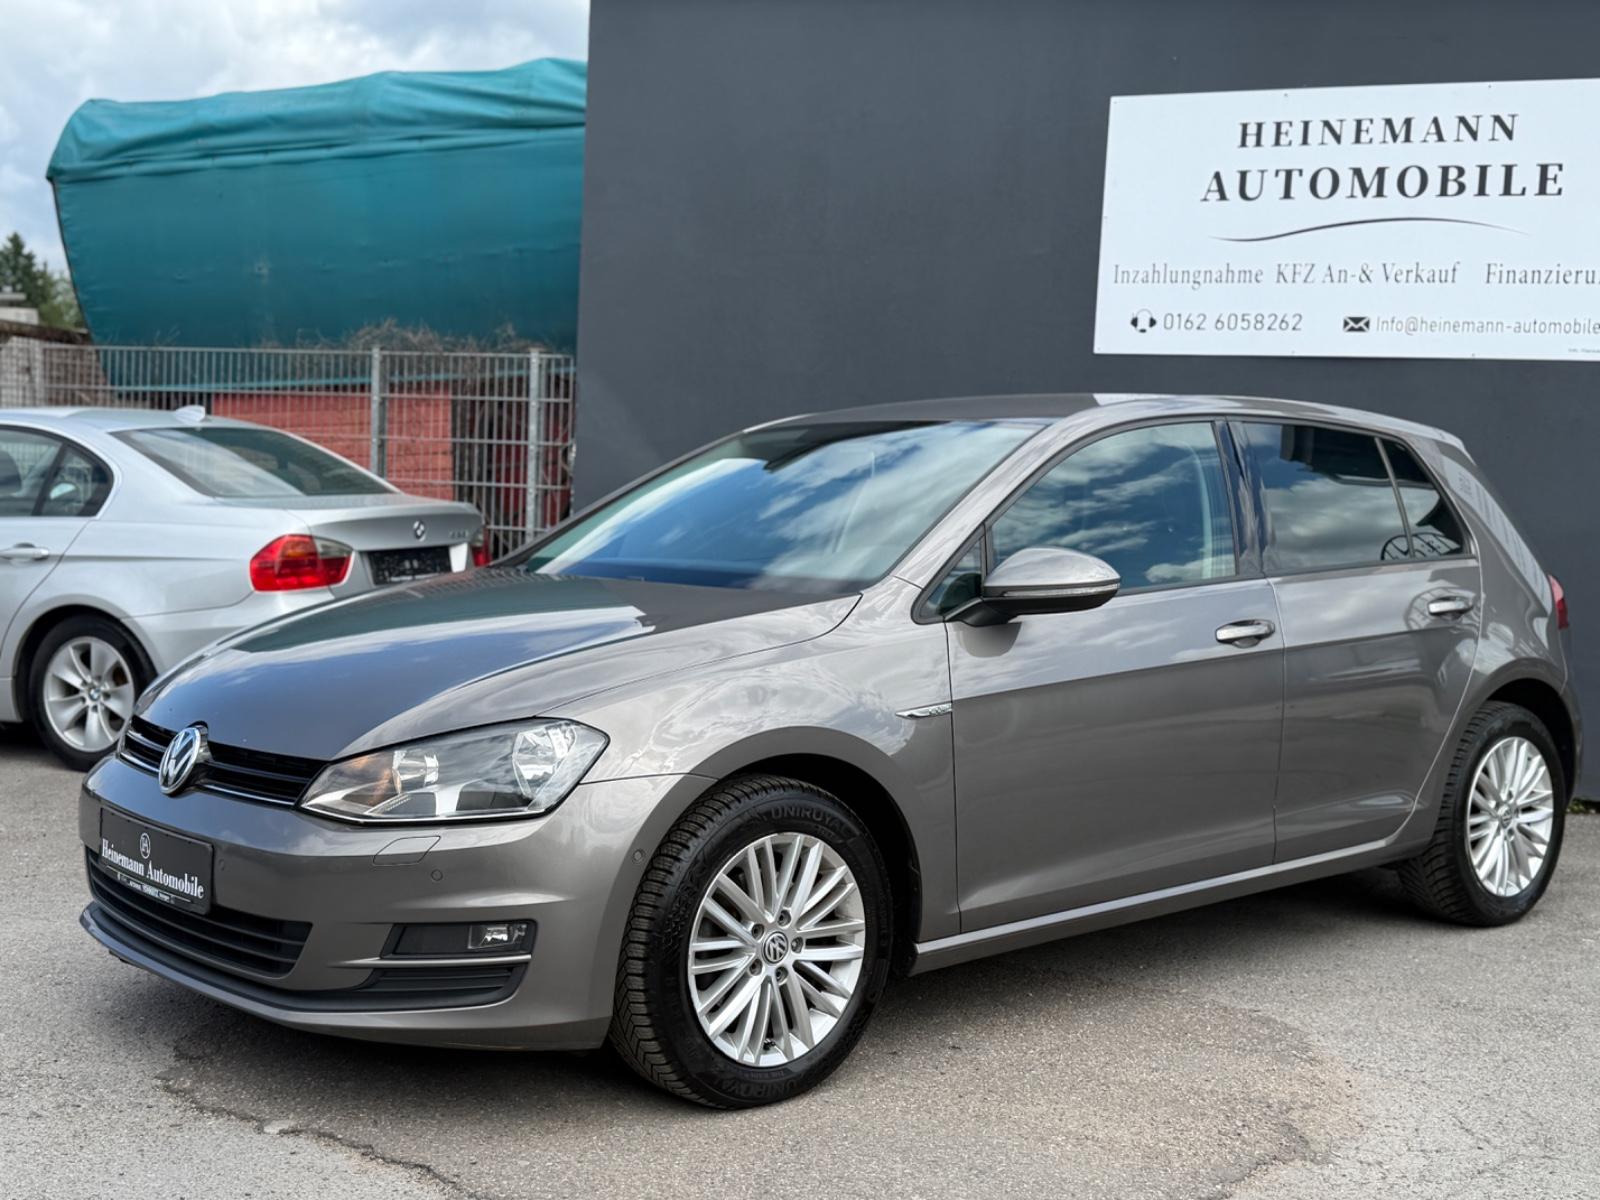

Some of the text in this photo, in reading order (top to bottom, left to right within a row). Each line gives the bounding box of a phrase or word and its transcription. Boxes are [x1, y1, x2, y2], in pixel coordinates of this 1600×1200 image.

[1237, 114, 1519, 148] HEINEMANN
[1200, 163, 1564, 202] AUTOMOBILE
[1113, 263, 1264, 291] Inzahlungnahme
[1275, 263, 1316, 284] KFZ
[1381, 261, 1461, 284] Verkauf
[1485, 262, 1600, 285] Finanzieru
[1163, 312, 1303, 331] 0162 6058262
[102, 838, 145, 877] Heinemann
[146, 860, 204, 899] Automobile
